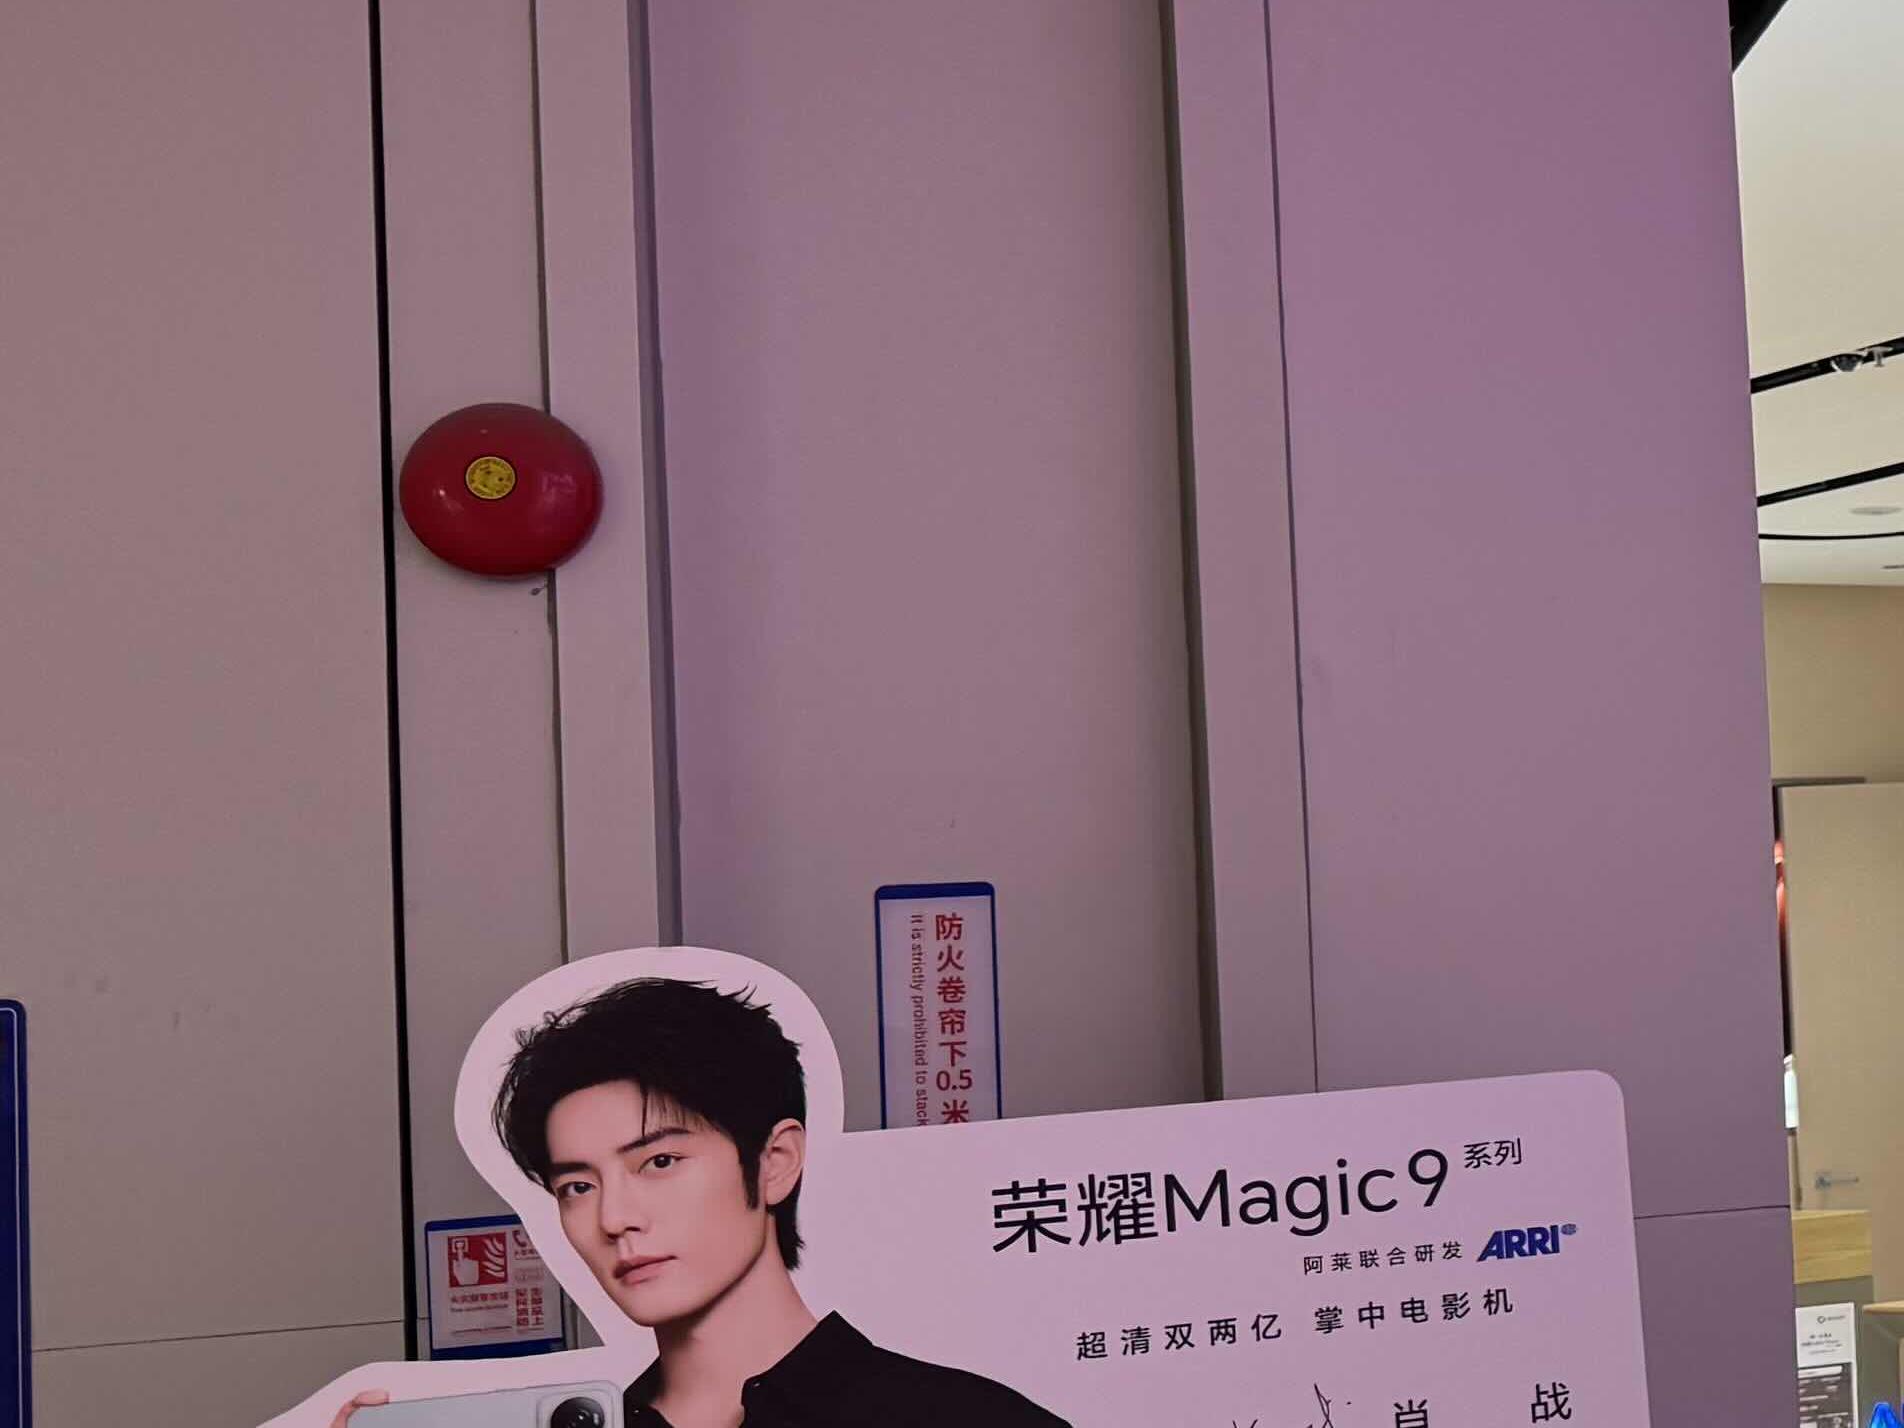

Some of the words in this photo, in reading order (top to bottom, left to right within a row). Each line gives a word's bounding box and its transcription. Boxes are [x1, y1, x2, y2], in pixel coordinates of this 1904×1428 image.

[991, 1148, 1450, 1254] 荣耀Magic9
[1463, 1138, 1524, 1170] 系列
[1303, 1241, 1463, 1276] 阿莱联合研发
[1076, 1312, 1284, 1362] 超清双两亿
[1315, 1288, 1515, 1335] 掌中电影机
